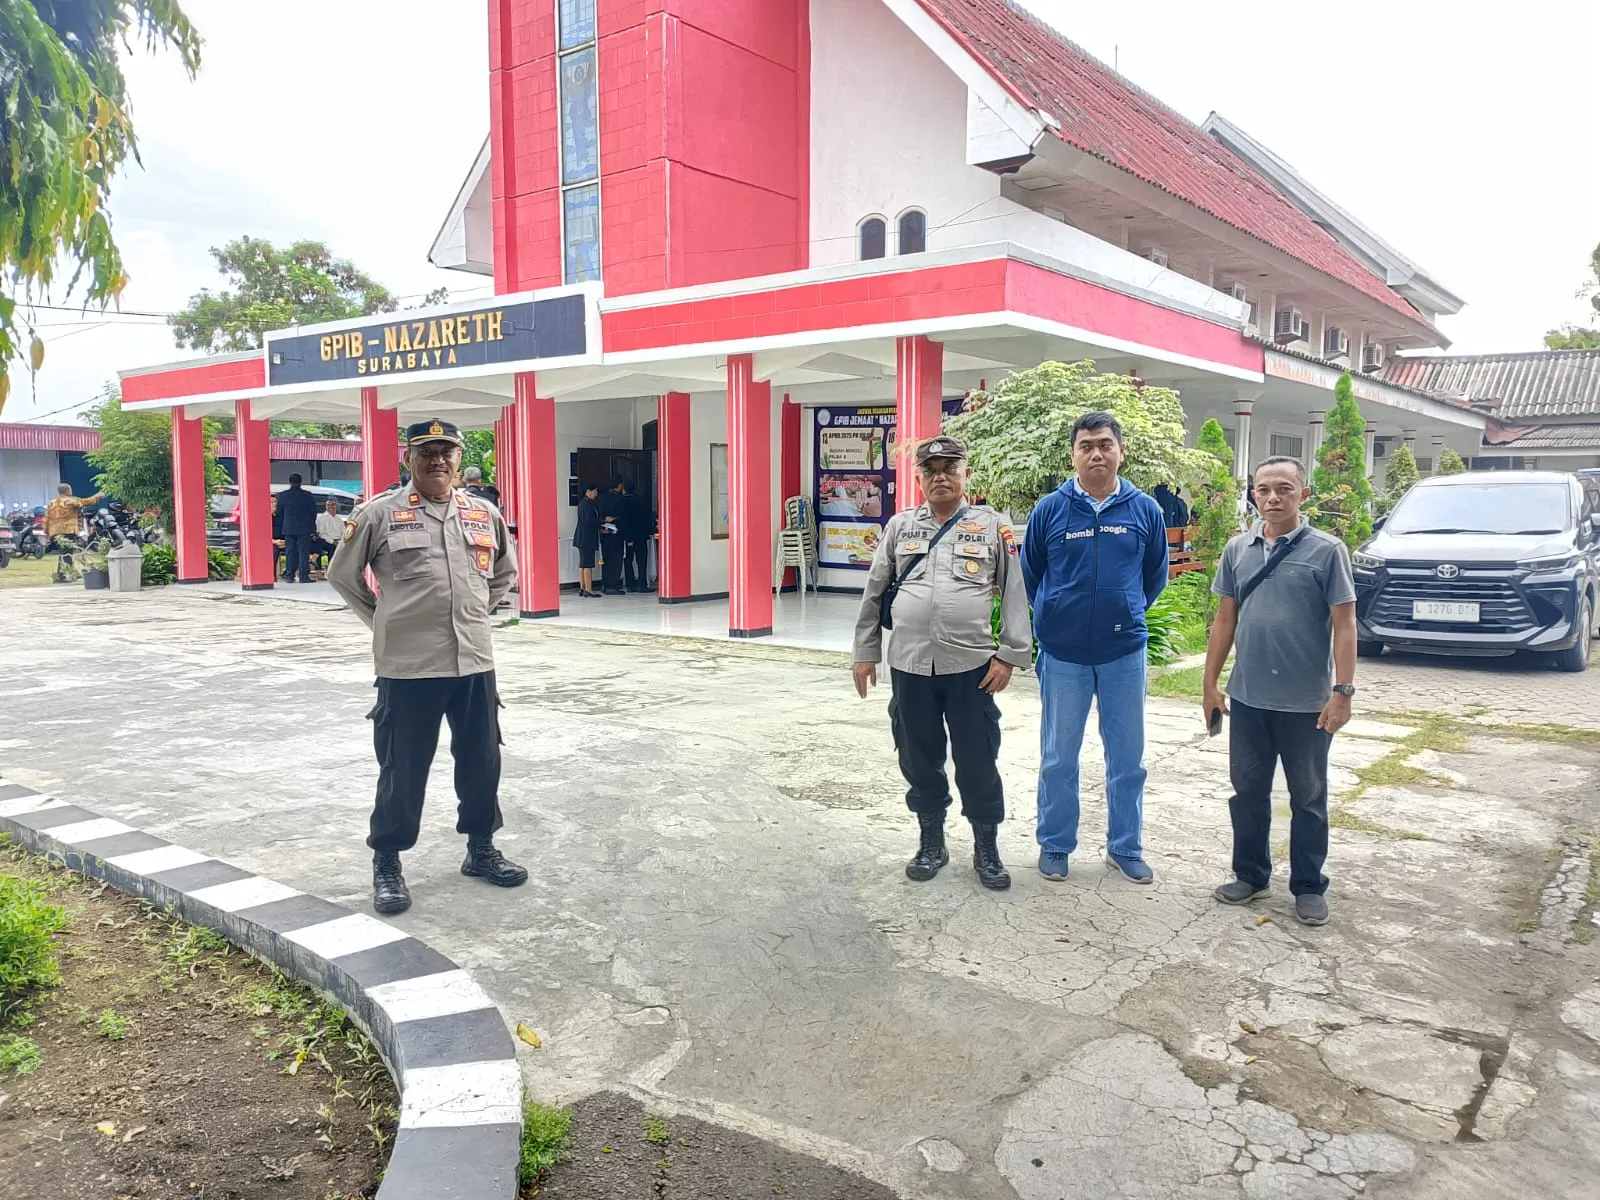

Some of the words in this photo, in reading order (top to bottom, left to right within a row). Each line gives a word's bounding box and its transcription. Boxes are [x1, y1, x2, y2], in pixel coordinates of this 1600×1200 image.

[320, 332, 363, 362] GPIB
[384, 311, 504, 353] NAZARETH
[357, 349, 457, 374] SURABAYA
[957, 533, 986, 542] POLRI
